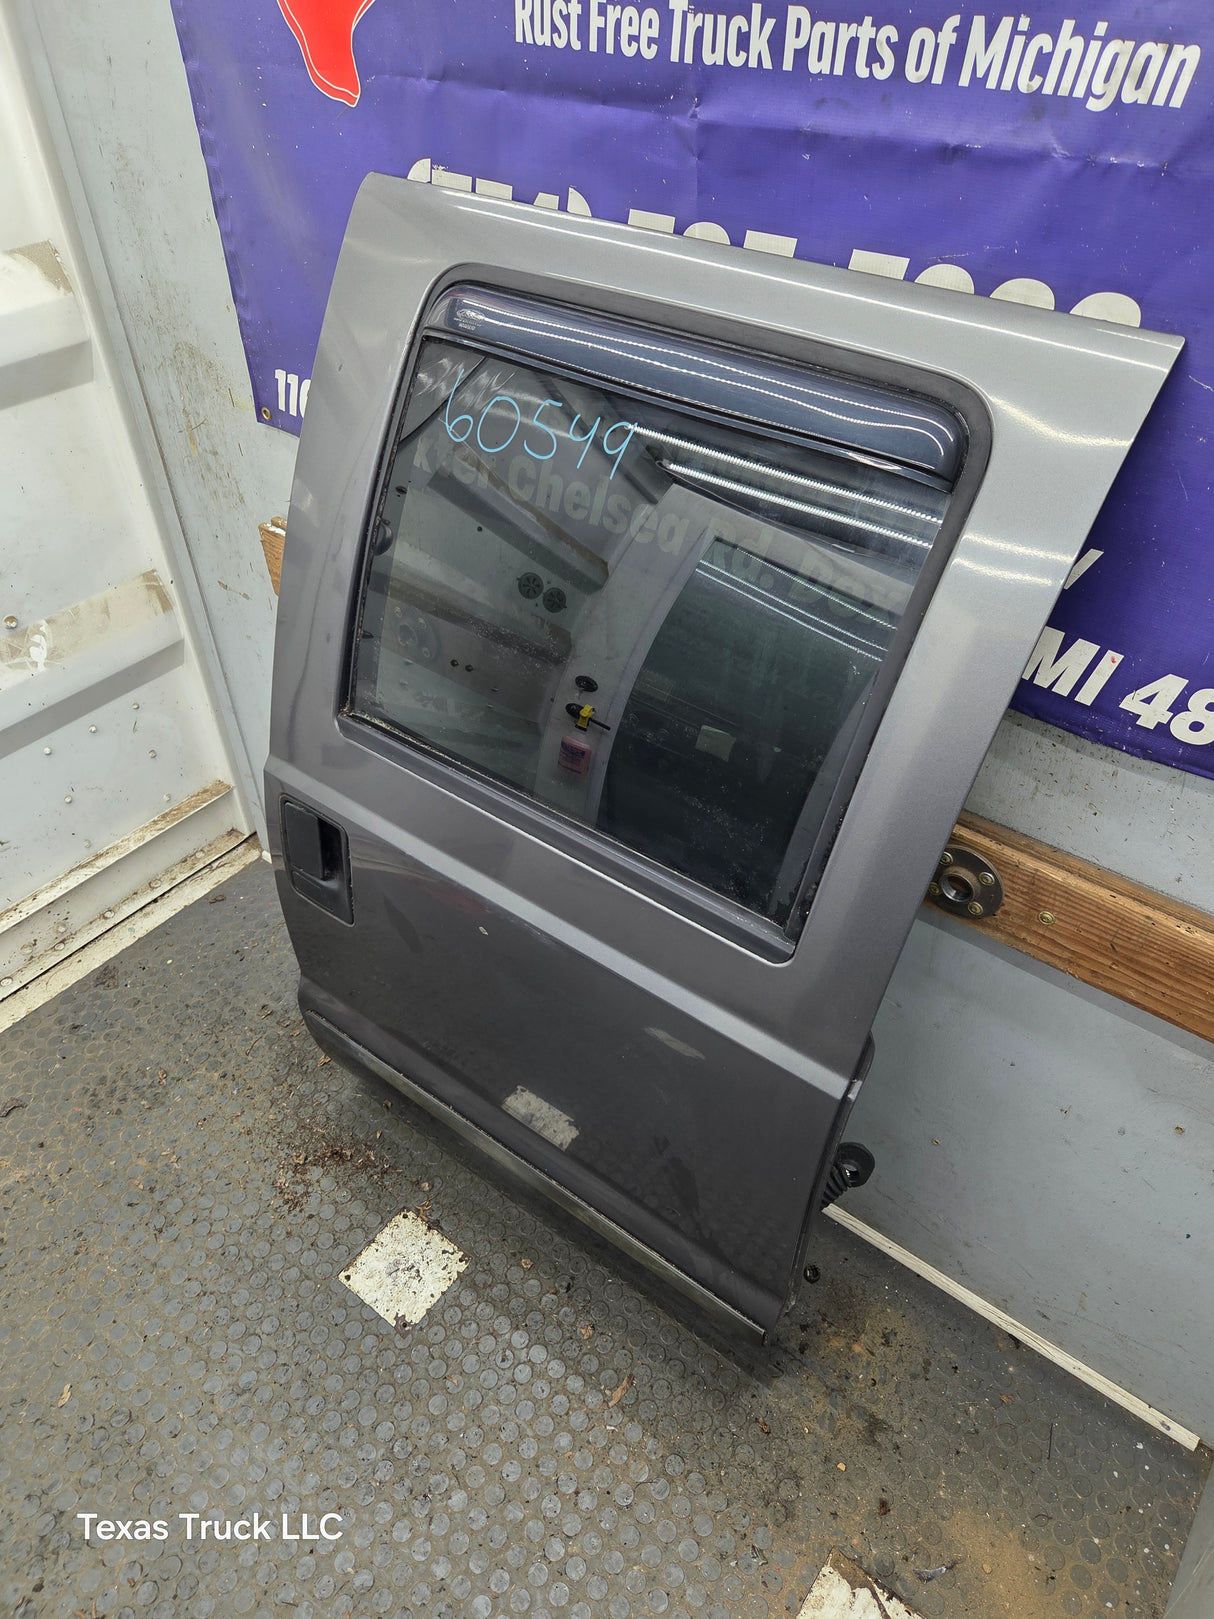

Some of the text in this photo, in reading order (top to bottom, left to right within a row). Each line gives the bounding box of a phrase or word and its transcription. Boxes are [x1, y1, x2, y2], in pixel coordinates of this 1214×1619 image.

[513, 0, 1201, 112] Rust Free Truck Parts of Michigan
[442, 368, 638, 480] 60549
[507, 454, 690, 557] Chelsea
[1021, 625, 1125, 707] MI
